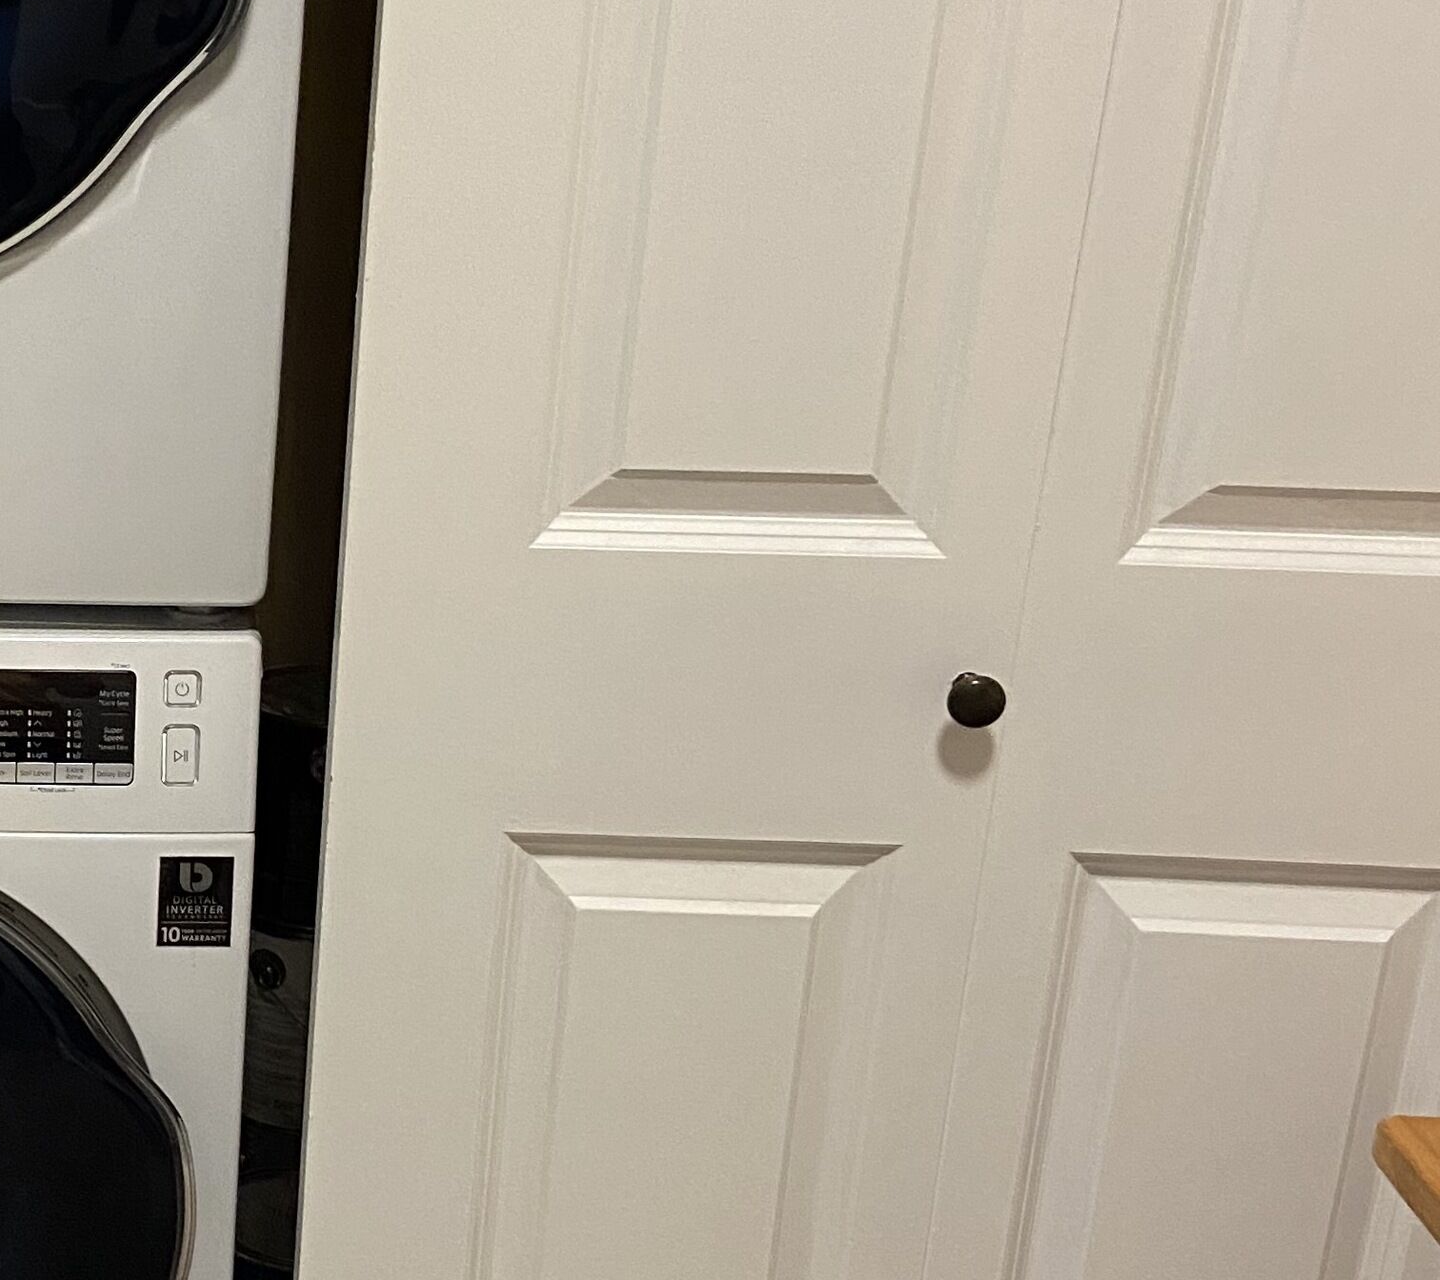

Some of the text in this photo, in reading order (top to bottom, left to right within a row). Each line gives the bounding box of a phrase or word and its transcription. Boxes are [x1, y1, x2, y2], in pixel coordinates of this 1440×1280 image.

[117, 770, 130, 778] End
[173, 895, 217, 904] DIGITAL
[166, 905, 224, 914] INVERTER
[161, 926, 181, 943] 10
[182, 934, 226, 942] WARRANTY
